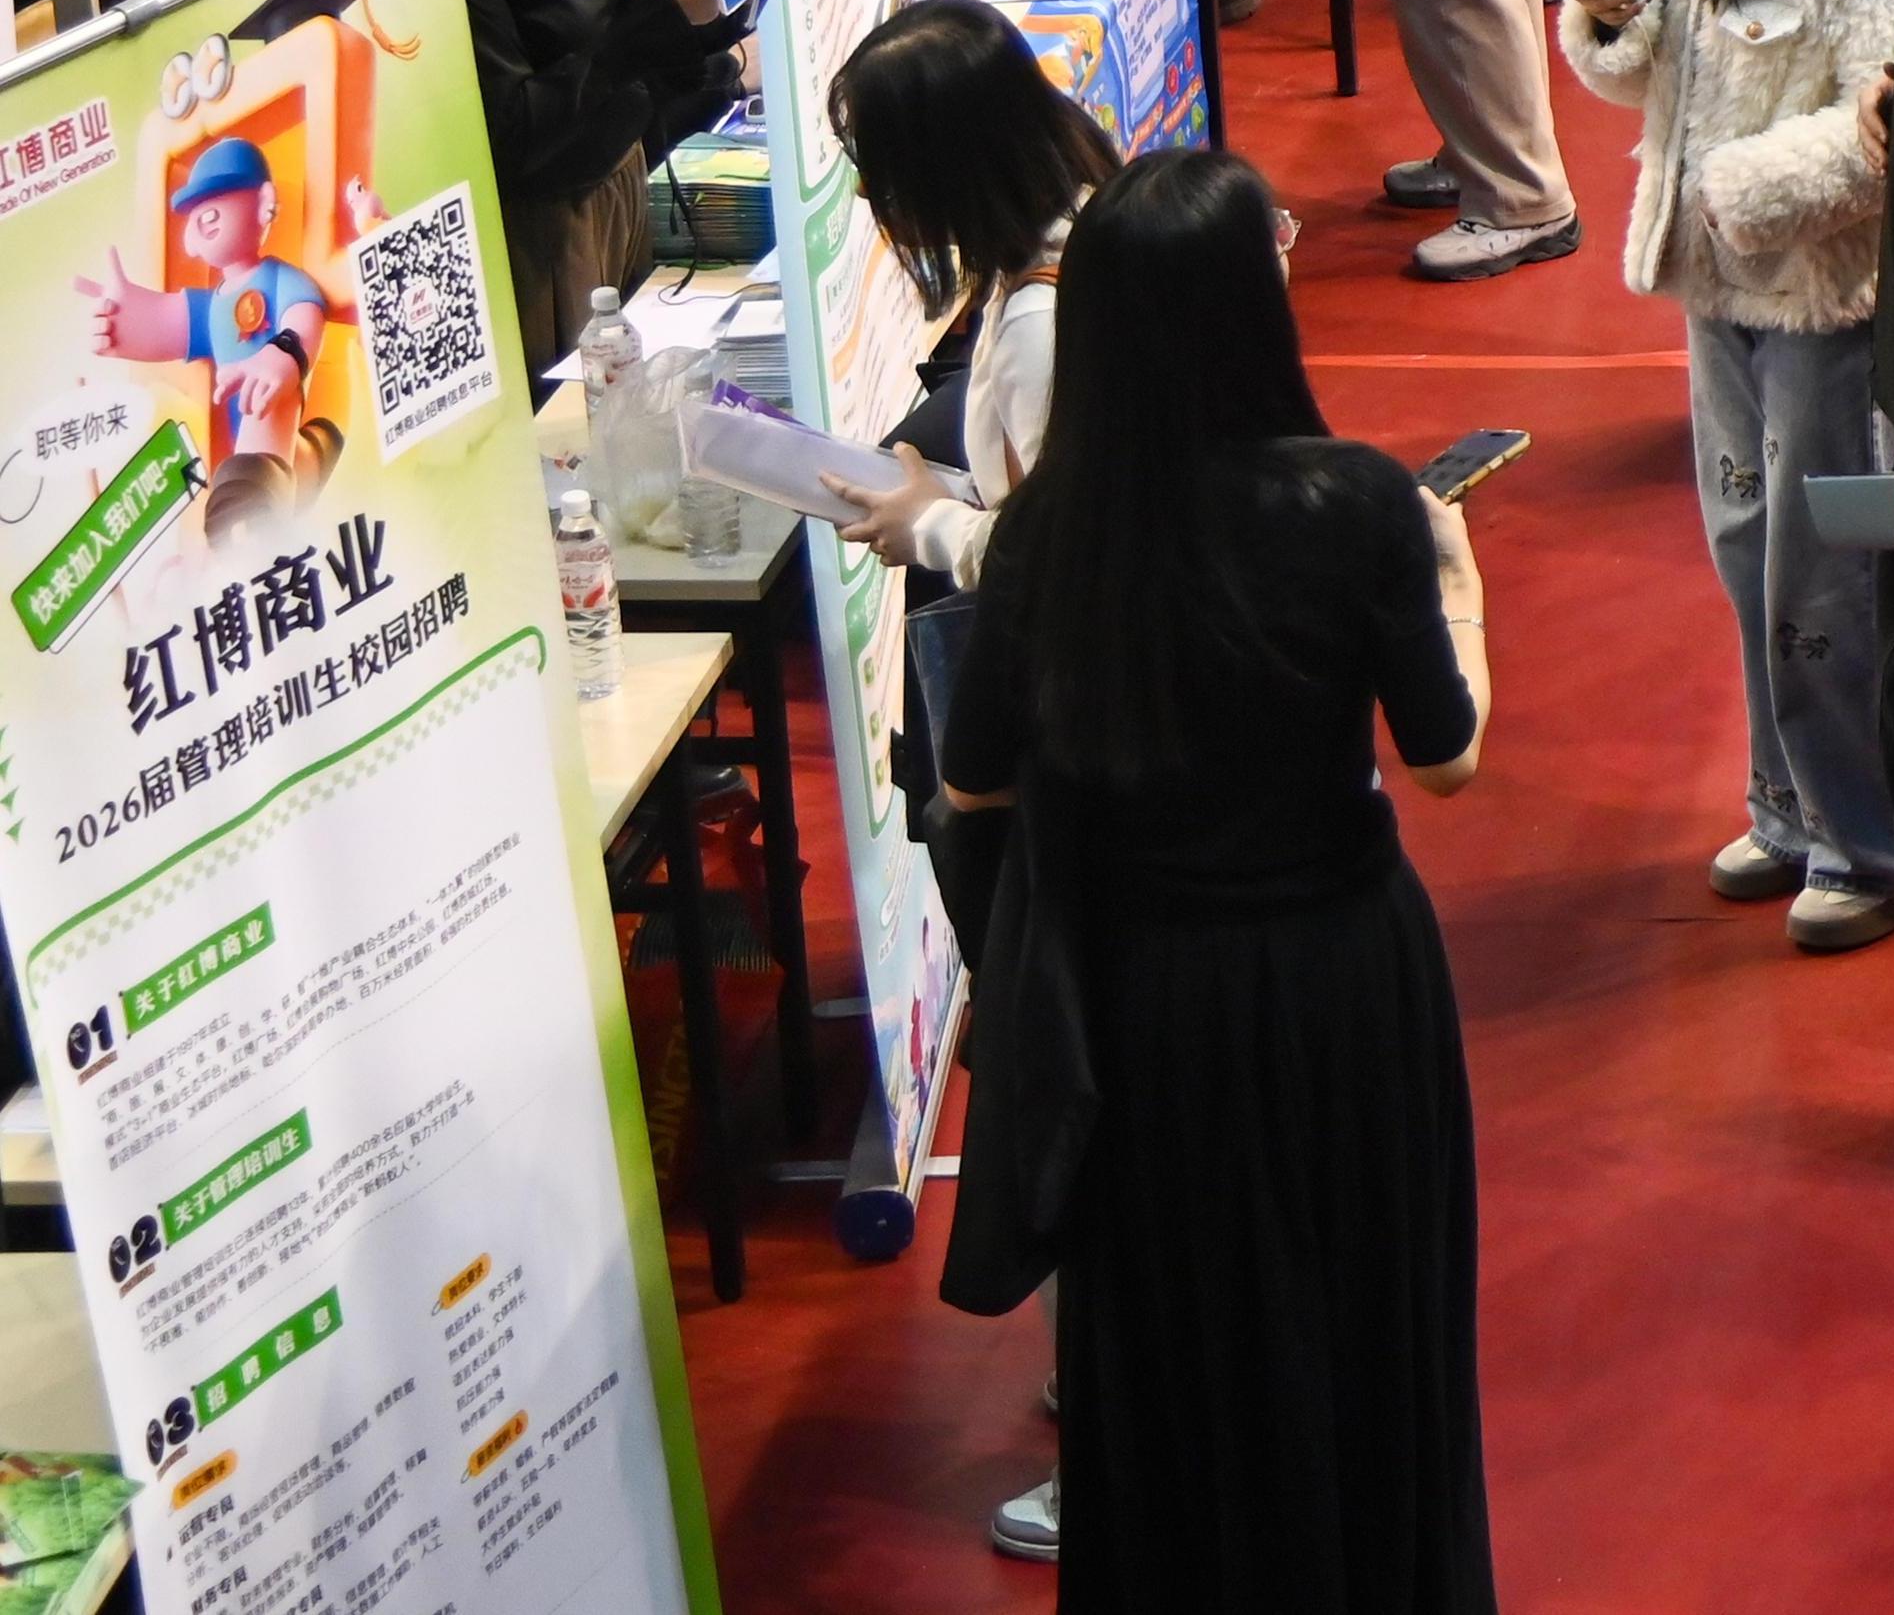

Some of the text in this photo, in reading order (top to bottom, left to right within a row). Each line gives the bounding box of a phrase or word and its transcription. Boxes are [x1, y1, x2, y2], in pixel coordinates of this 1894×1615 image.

[34, 176, 59, 196] New
[60, 147, 116, 185] Generation
[35, 403, 128, 460] 职等你来
[385, 369, 493, 447] 红博商业招聘信息平台
[121, 511, 395, 736] 红博商业
[55, 572, 470, 865] 2026届管理培训生校园招聘
[134, 917, 266, 1022] 关于红博商业
[67, 1005, 113, 1071] 01
[172, 1126, 303, 1232] 关于管理培训生
[108, 1215, 162, 1283] 02
[205, 1308, 332, 1411] 招聘信息
[145, 1396, 196, 1466] 03
